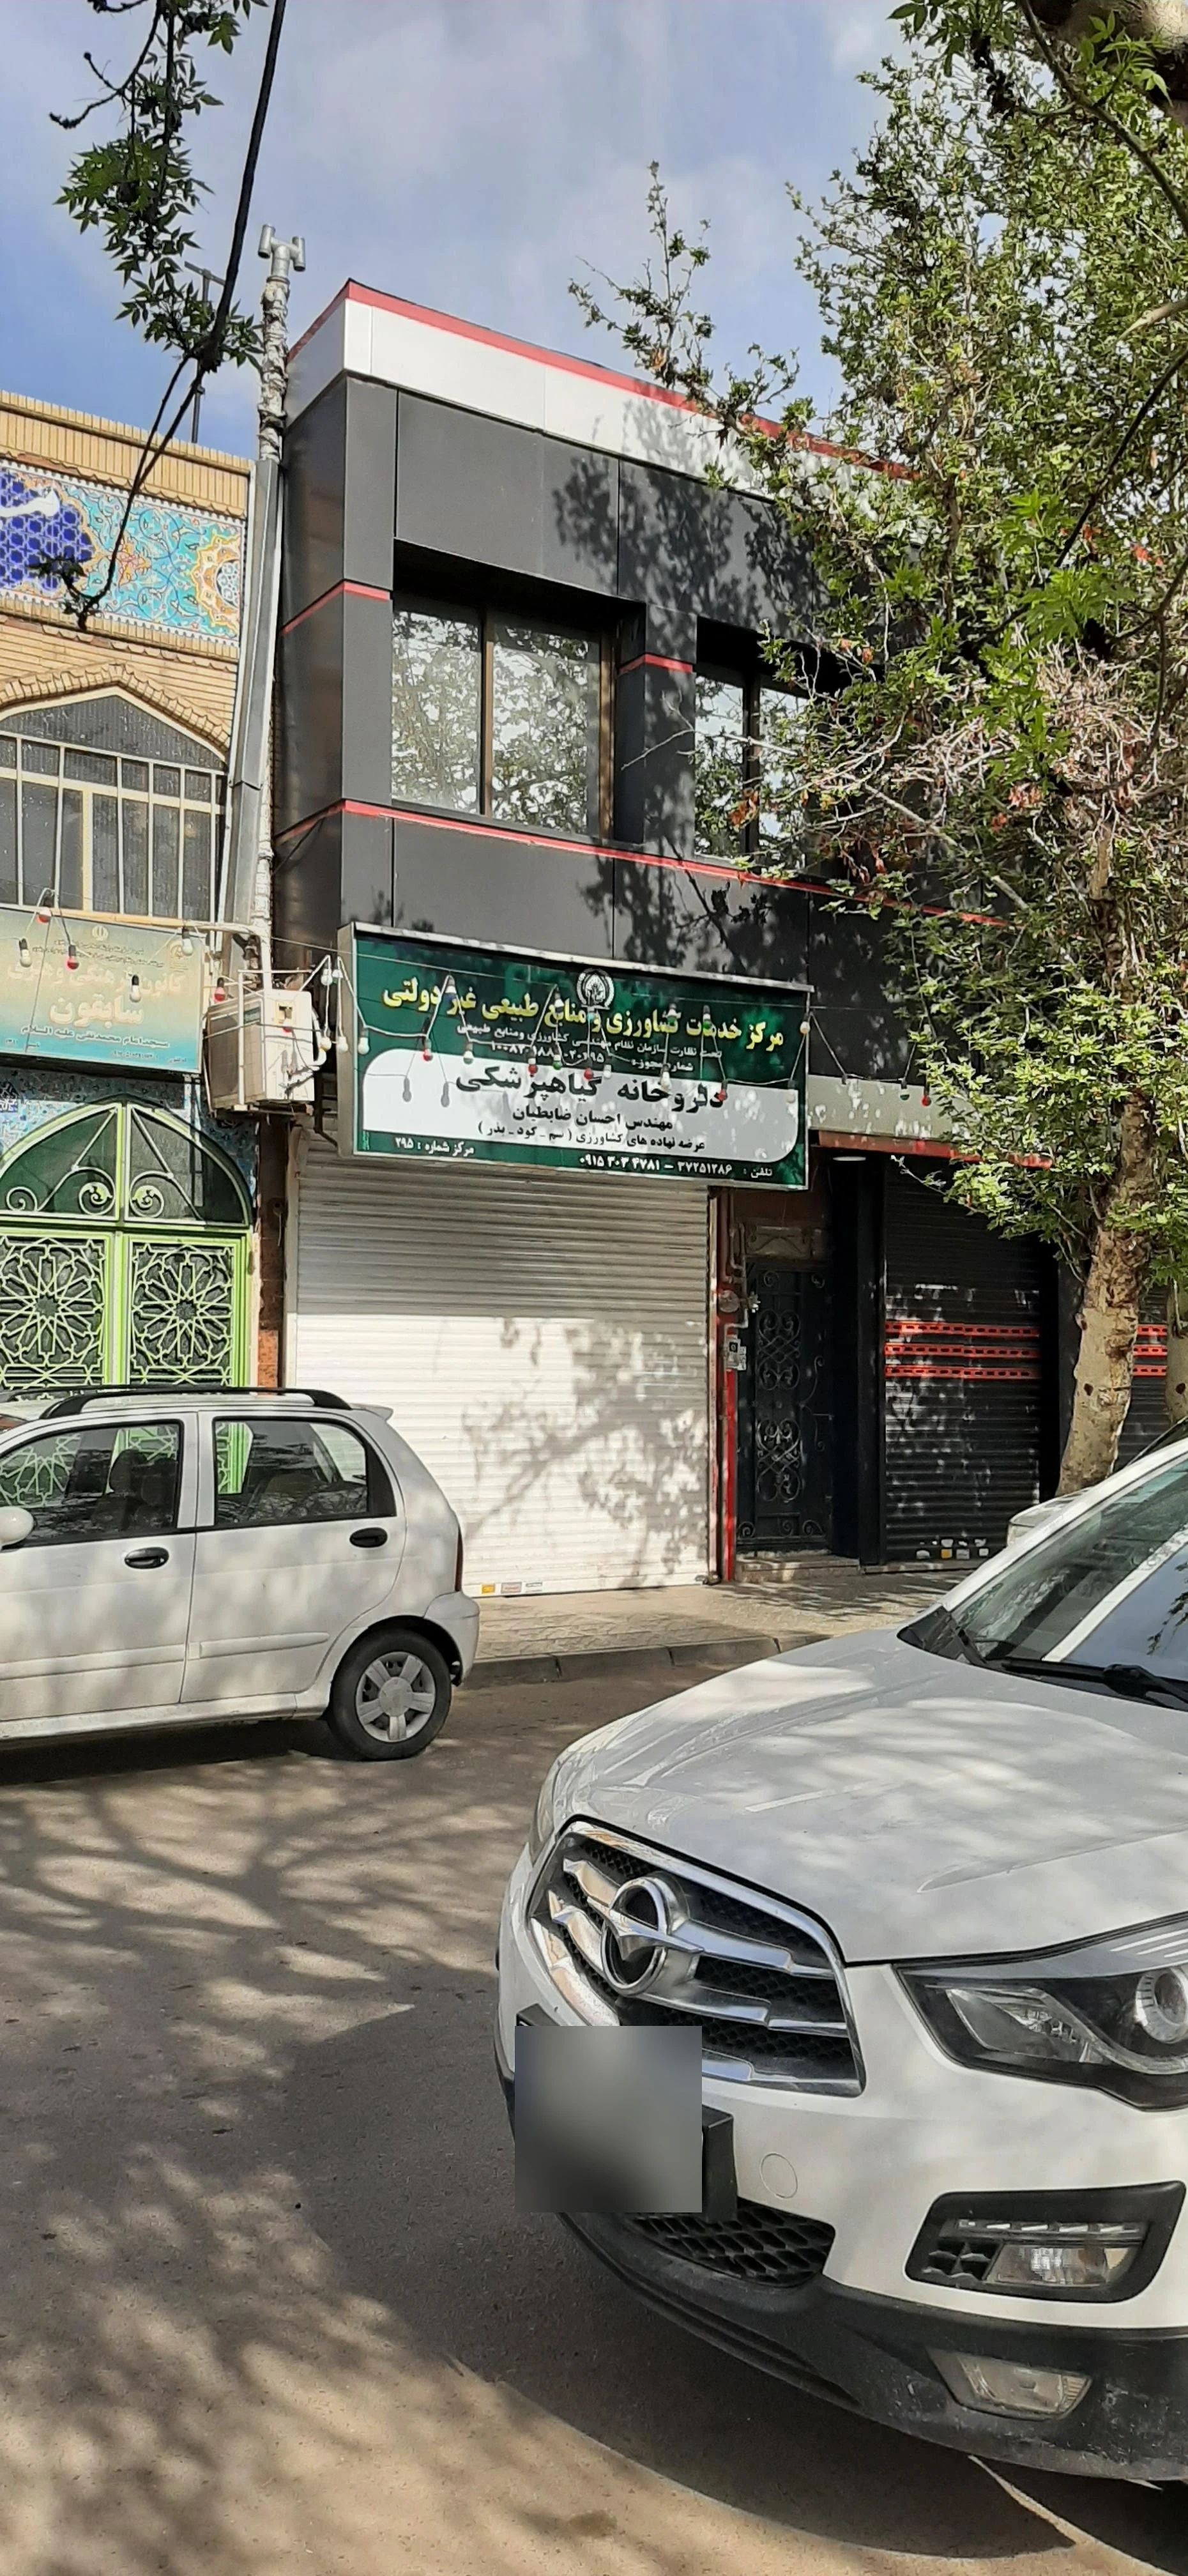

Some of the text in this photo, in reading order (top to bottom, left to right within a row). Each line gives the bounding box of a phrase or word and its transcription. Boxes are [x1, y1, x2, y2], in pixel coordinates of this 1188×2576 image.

[383, 976, 443, 1011] دولتی
[446, 986, 477, 1016] غیر
[49, 993, 144, 1029] سابقون
[481, 993, 539, 1022] طبیعی
[544, 997, 587, 1029] منابع
[456, 1022, 491, 1034] طبیعی
[591, 1011, 602, 1033] و
[607, 1008, 682, 1038] کشاورزی
[526, 1031, 570, 1043] کشاورزی
[572, 1037, 613, 1049] مهندسی
[746, 1021, 784, 1052] مرکز
[614, 1039, 634, 1050] نظام
[636, 1042, 667, 1054] سازمان
[670, 1046, 697, 1057] نظارت
[616, 1078, 729, 1114] داروخانه
[512, 1103, 673, 1130] مهندس احسان ضابطیان
[487, 1122, 506, 1137] بذر
[517, 1126, 538, 1139] کود
[549, 1132, 564, 1143] سم
[575, 1130, 623, 1146] کشاورزی
[626, 1134, 647, 1147] های
[650, 1135, 676, 1150] نهاده
[678, 1138, 706, 1151] عرضه
[424, 1140, 450, 1154] شماره
[452, 1140, 475, 1157] مرکز
[750, 1166, 773, 1179] تلفن
